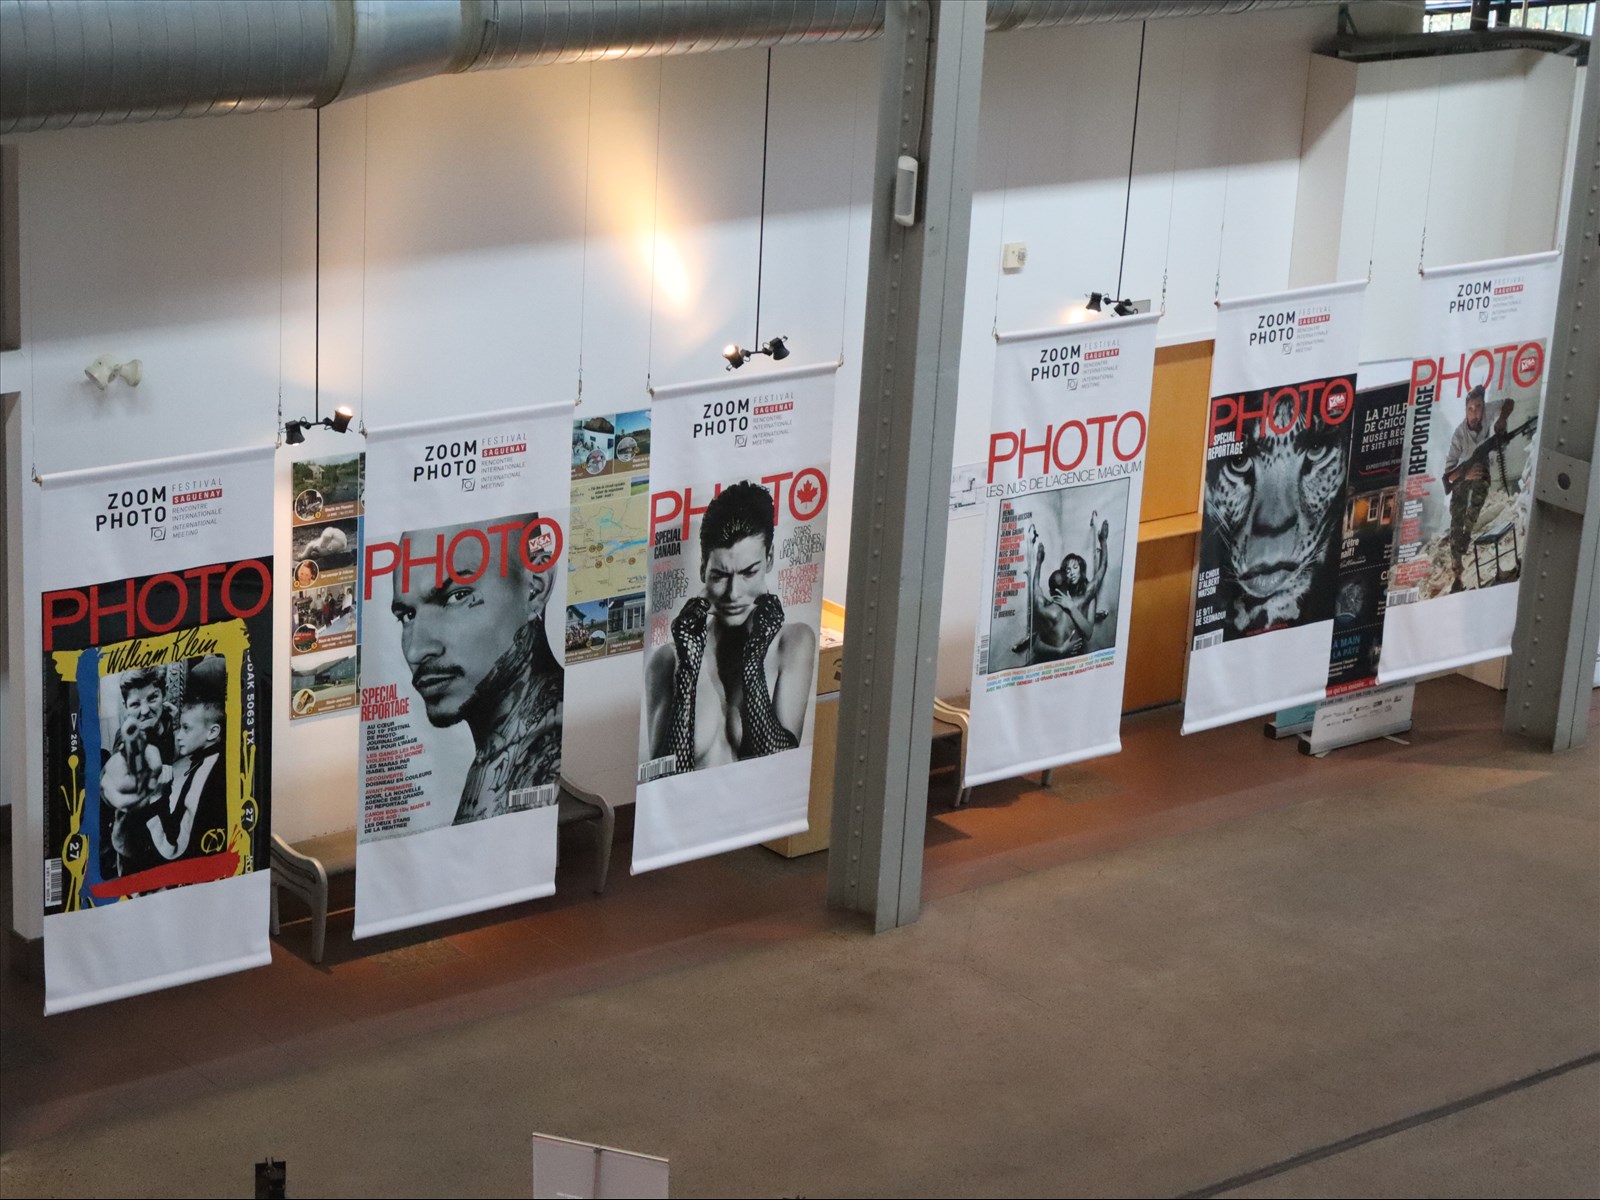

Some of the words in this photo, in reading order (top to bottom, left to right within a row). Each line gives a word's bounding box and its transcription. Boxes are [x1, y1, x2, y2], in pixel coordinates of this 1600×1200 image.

[1457, 280, 1492, 297] ZOOM
[1298, 306, 1331, 316] FESTIVAL
[1449, 296, 1490, 314] PHOTO
[1258, 311, 1296, 329] ZOOM
[1249, 327, 1294, 346] PHOTO
[1084, 339, 1120, 350] FESTIVAL
[1040, 345, 1081, 363] ZOOM
[1085, 349, 1119, 360] SAGUENAY
[1031, 361, 1079, 381] PHOTO
[1408, 342, 1545, 407] PHOTO
[753, 392, 794, 403] FESTIVAL
[703, 398, 750, 419] ZOOM
[754, 402, 793, 415] SAGUENAY
[1208, 378, 1354, 448] PHOTO
[1365, 409, 1379, 422] LA
[693, 416, 749, 438] PHOTO
[752, 420, 792, 430] INTERNATIONALE
[1364, 422, 1377, 433] DE
[1378, 416, 1405, 430] CHICO
[1408, 384, 1435, 476] REPORTAGE
[482, 433, 527, 446] FESTIVAL
[752, 429, 789, 439] INTERNATIONAL
[1213, 431, 1236, 445] SPECIAL
[1362, 430, 1388, 444] MUSÉE
[1389, 428, 1405, 438] RÉG
[425, 440, 477, 461] ZOOM
[483, 444, 526, 457] SAGUENAY
[987, 411, 1147, 484] PHOTO
[1208, 441, 1243, 460] REPORTAGE
[1361, 444, 1369, 453] ET
[1371, 441, 1386, 451] SITE
[1387, 437, 1403, 447] HIST
[481, 457, 513, 466] RENCONTRE
[481, 462, 526, 473] INTERNATIONALE
[413, 459, 477, 482] PHOTO
[481, 472, 521, 482] INTERNATIONAL
[172, 478, 222, 492] FESTIVAL
[481, 482, 504, 490] MEETING
[986, 484, 1004, 498] LES
[1007, 479, 1026, 495] NUS
[1030, 477, 1044, 490] DE
[1045, 468, 1095, 487] L'AGENCE
[1098, 460, 1142, 478] MAGNUM
[107, 486, 166, 510] ZOOM
[173, 490, 221, 504] SAGUENAY
[172, 503, 207, 513] RENCONTRE
[172, 508, 222, 521] INTERNATIONALE
[650, 467, 828, 547] PHTO
[96, 506, 166, 531] PHOTO
[172, 519, 217, 531] INTERNATIONAL
[172, 530, 199, 538] MEETING
[655, 528, 681, 545] SPECIAL
[530, 535, 551, 549] VISA
[654, 542, 681, 559] CANADA
[364, 517, 564, 600] PHOTO
[1199, 571, 1205, 581] LE
[1206, 567, 1220, 579] CHOIX
[1198, 576, 1220, 590] D'ALBERT
[43, 559, 272, 652] PHOTO
[1196, 609, 1202, 618] LE
[1195, 617, 1202, 627] DE
[1341, 635, 1360, 648] MAIN
[107, 638, 169, 674] William
[171, 626, 218, 660] Klein
[361, 684, 398, 705] SPECIAL
[246, 693, 255, 726] 5063
[361, 697, 410, 722] REPORTAGE
[388, 723, 411, 733] FESTIVAL
[70, 734, 78, 752] 26A
[246, 728, 255, 745] TX
[367, 735, 405, 746] JOURNALISME
[398, 737, 418, 747] L'IMAGE
[366, 756, 394, 764] VIOLENTS
[404, 749, 422, 758] MONDE
[378, 760, 398, 768] MARAS
[366, 779, 395, 787] DOISNEAU
[405, 770, 433, 781] COULEURS
[393, 786, 421, 796] NOUVELLE
[403, 790, 424, 799] GRANDS
[365, 810, 384, 818] CANON
[410, 803, 425, 811] MARK
[374, 800, 408, 810] REPORTAGE
[245, 807, 254, 822] 27
[70, 842, 79, 859] 27
